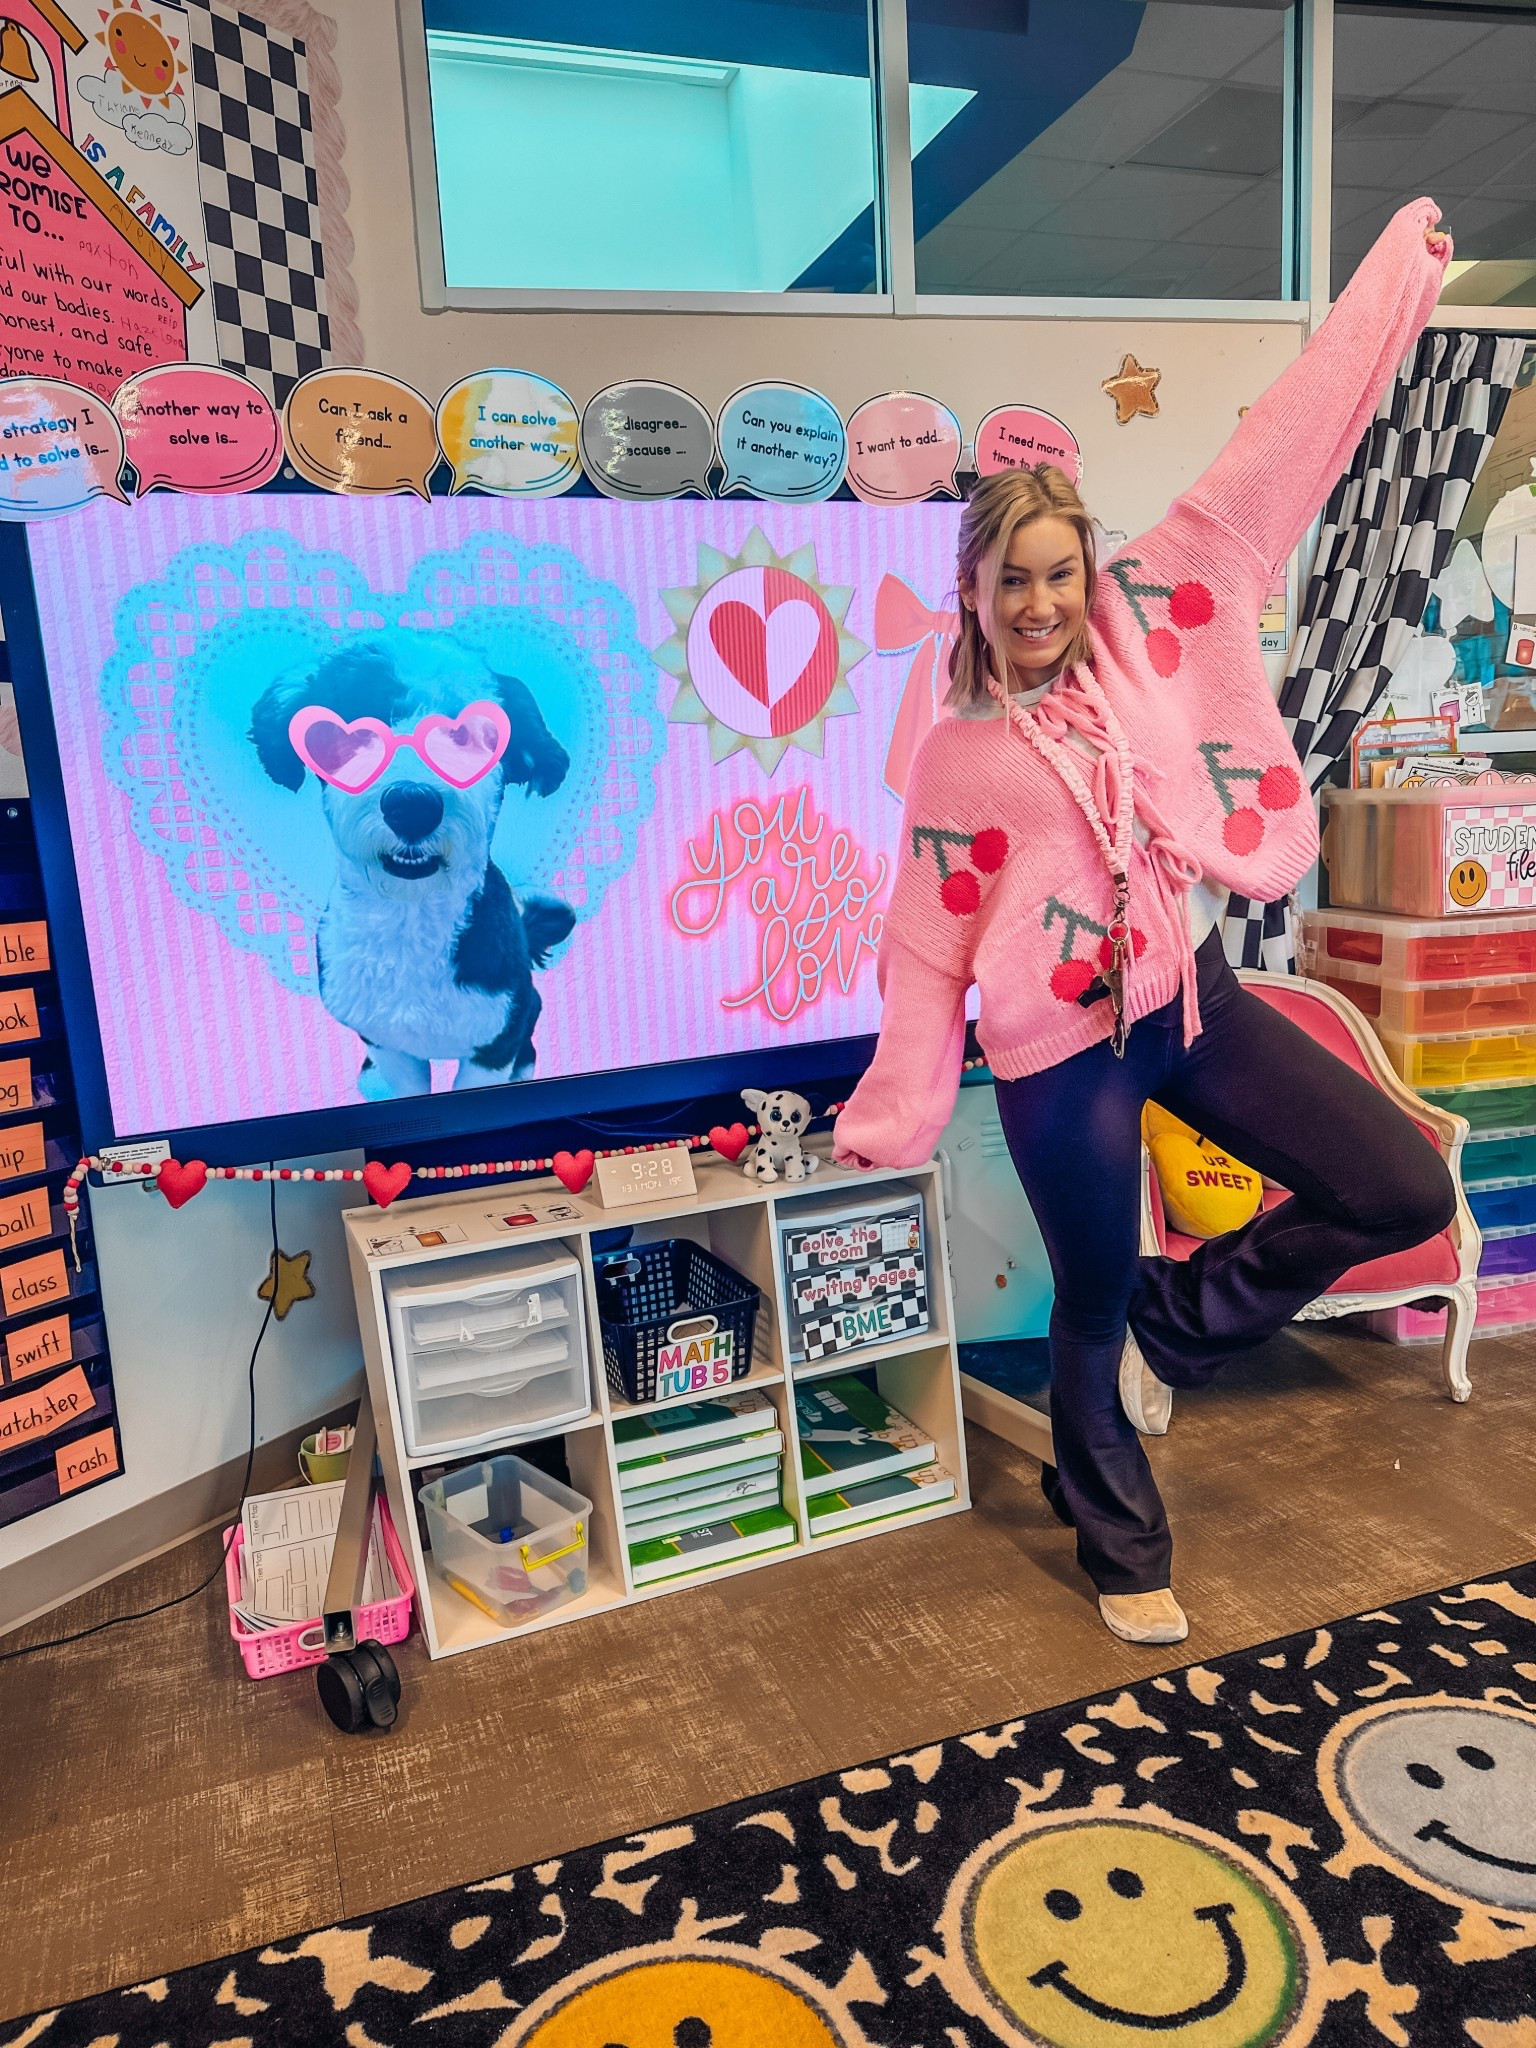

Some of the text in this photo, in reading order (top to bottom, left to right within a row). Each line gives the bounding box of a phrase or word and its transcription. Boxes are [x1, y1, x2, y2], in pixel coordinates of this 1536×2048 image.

[80, 133, 206, 273] IS A FAMILY
[33, 261, 75, 286] with
[81, 276, 113, 294] our
[122, 286, 175, 313] words,
[21, 291, 48, 306] our
[54, 291, 115, 324] bodies.
[71, 326, 109, 346] and
[117, 335, 160, 359] safe.
[0, 343, 45, 363] yone
[53, 349, 72, 369] to
[77, 359, 123, 378] make
[3, 408, 94, 440] strategy I
[135, 399, 263, 419] Another way to
[318, 398, 408, 424] Can I ask a
[477, 405, 557, 426] I can solve
[169, 429, 209, 445] solve
[742, 410, 838, 443] Can you explain
[999, 426, 1066, 457] I need more
[14, 451, 33, 468] to
[38, 445, 81, 467] solve
[468, 437, 525, 451] another
[617, 442, 671, 457] ecause
[736, 437, 838, 469] it another way?
[856, 441, 865, 455] I
[867, 440, 896, 453] want
[899, 435, 912, 448] to
[992, 449, 1016, 467] time
[671, 786, 824, 935] you
[751, 833, 861, 915] are
[792, 855, 887, 954] so
[0, 934, 36, 964] ble
[631, 1158, 674, 1180] 9:28
[1202, 1154, 1231, 1169] UR
[1185, 1170, 1253, 1192] SWEET
[802, 1226, 878, 1253] solve the
[820, 1244, 864, 1263] room
[11, 1275, 58, 1302] class
[803, 1267, 917, 1302] writing pages
[842, 1304, 892, 1341] BME
[15, 1330, 61, 1368] swift
[658, 1333, 732, 1374] MATH
[659, 1358, 729, 1398] TUB 5
[0, 1406, 43, 1437] atch
[66, 1446, 109, 1480] rash
